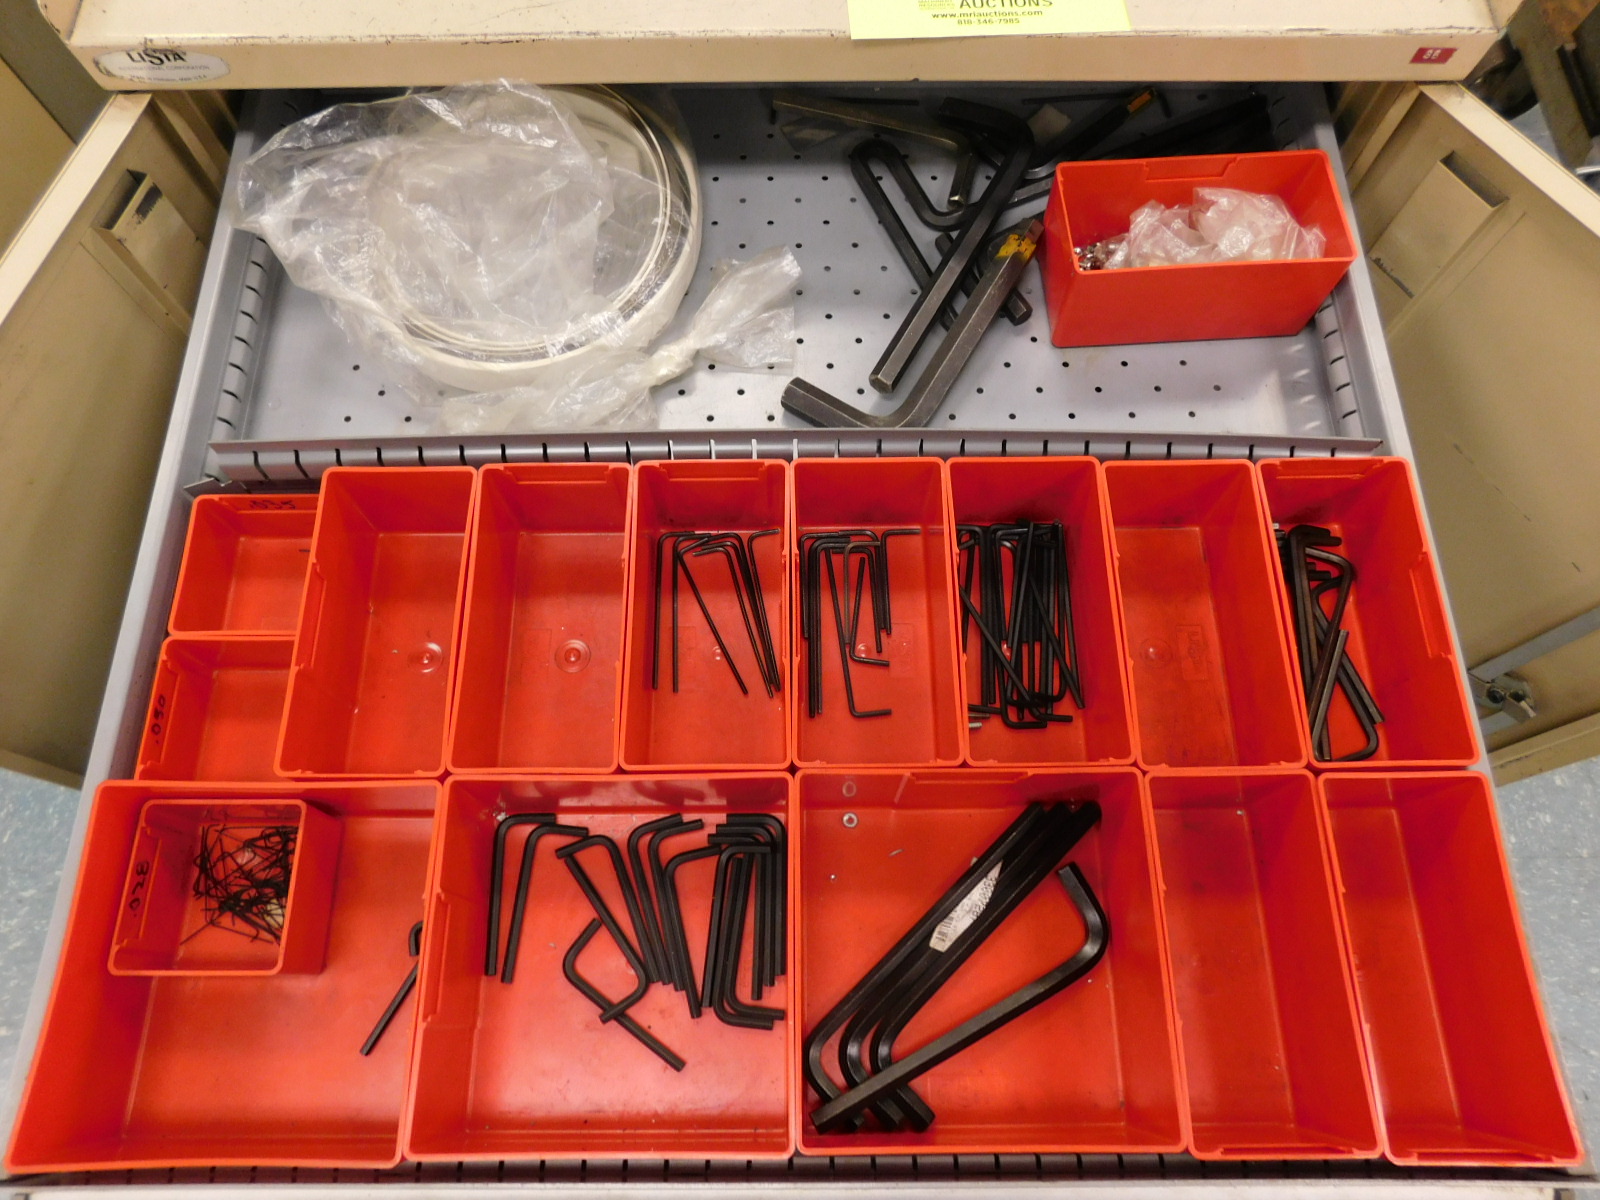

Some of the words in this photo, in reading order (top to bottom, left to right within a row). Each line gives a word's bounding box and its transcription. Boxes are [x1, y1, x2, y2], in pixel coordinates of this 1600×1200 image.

[959, 0, 1053, 9] AUCTIONS
[932, 10, 1043, 18] www.mriauctions.com
[126, 48, 187, 66] LISTA
